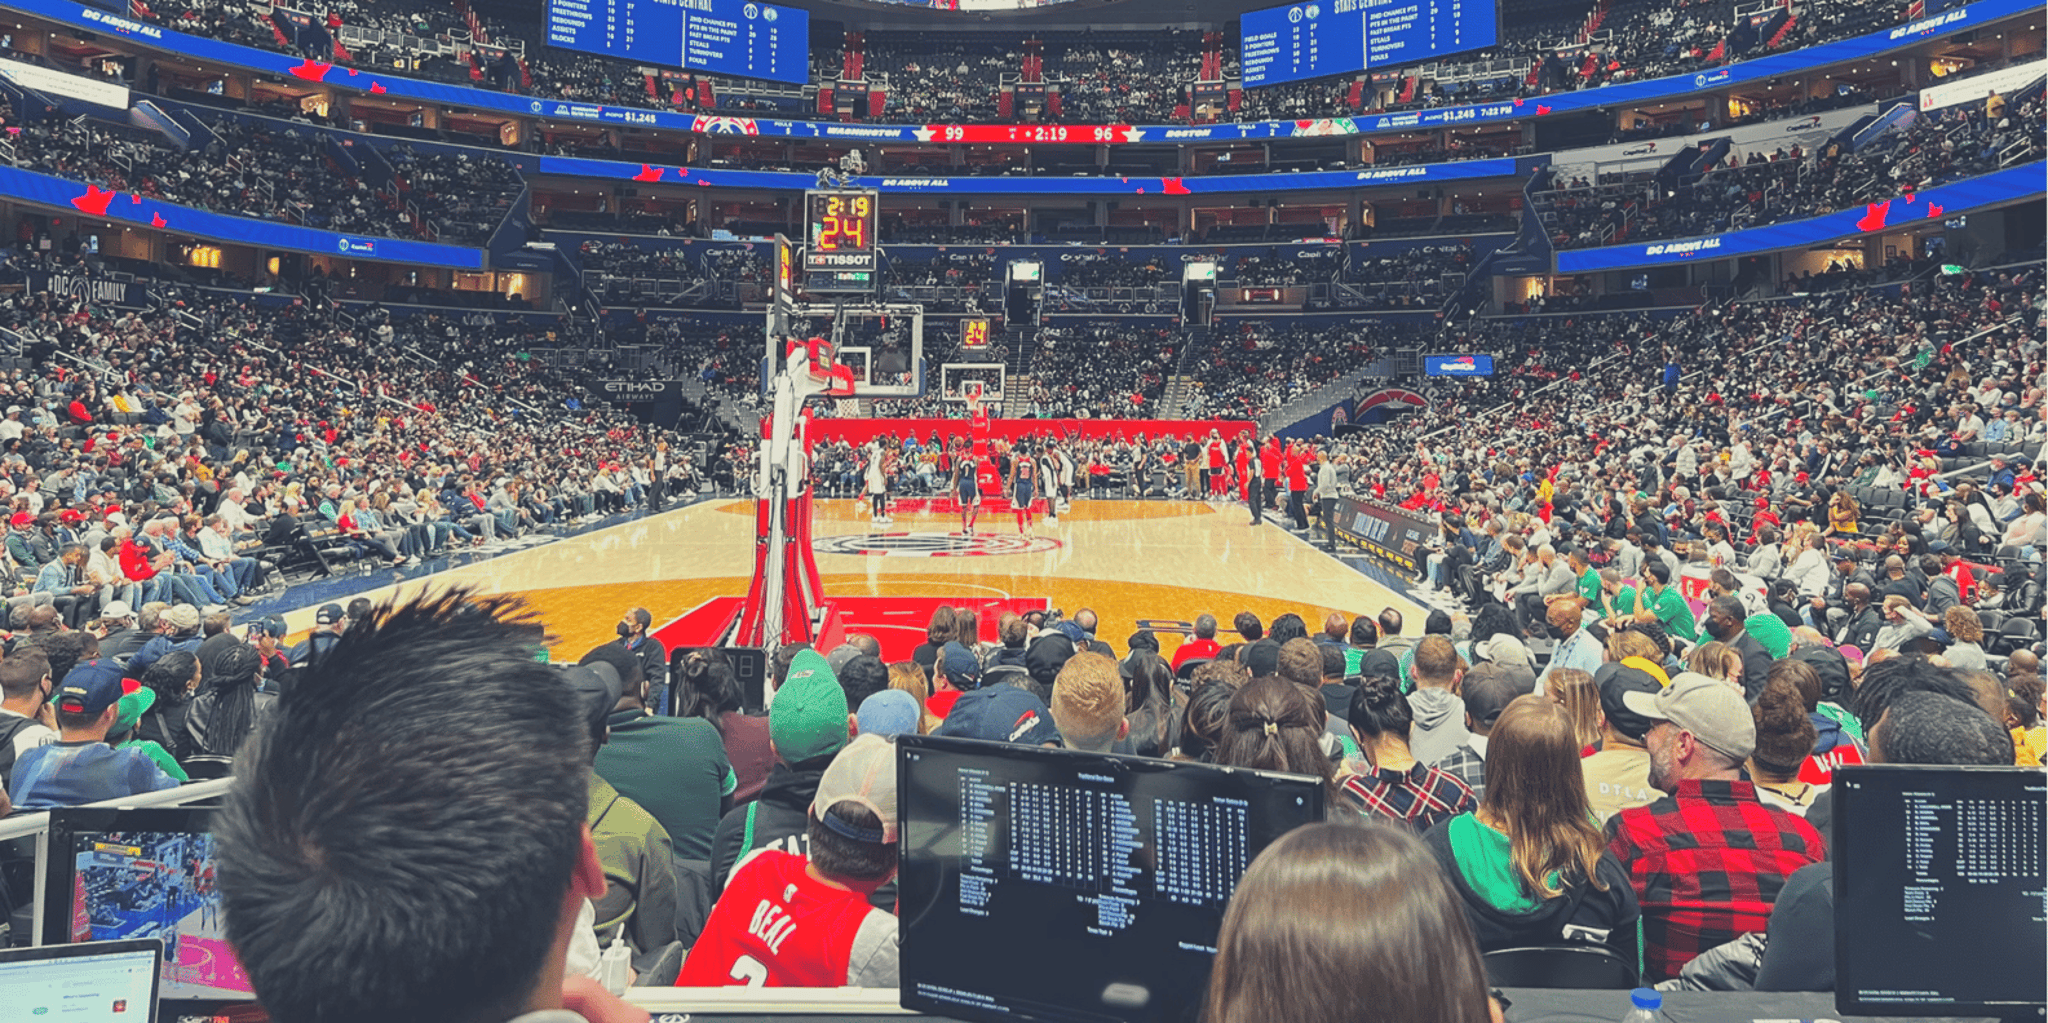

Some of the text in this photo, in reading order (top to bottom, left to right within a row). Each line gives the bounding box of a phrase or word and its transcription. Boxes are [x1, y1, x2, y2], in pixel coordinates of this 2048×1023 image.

[1384, 7, 1406, 17] CHANCE
[1400, 13, 1418, 22] PAINT
[82, 9, 162, 38] DC ABOVE ALL
[552, 16, 585, 27] REBOUNDS
[703, 18, 725, 26] CHANCE
[1890, 9, 1967, 40] DC ABOVE ALL
[552, 25, 576, 34] ASSISTS
[552, 34, 575, 43] BLOCKS
[1260, 32, 1277, 40] GOALS
[1370, 36, 1390, 45] STEALS
[690, 40, 709, 48] STEALS
[1371, 41, 1404, 53] TURNOVERS
[689, 48, 723, 58] TURNOVERS
[1371, 53, 1388, 62] FOULS
[689, 56, 707, 65] FOULS
[1245, 57, 1273, 66] REBOUNDS
[1245, 74, 1265, 82] BLOCKS
[625, 112, 656, 123] $1,245
[1443, 110, 1476, 122] $1,245
[1481, 108, 1498, 116] 7:22
[1500, 106, 1512, 114] PM
[827, 126, 902, 137] WASHINGTON
[946, 127, 964, 140] 99
[1035, 127, 1067, 140] 2:19
[1094, 127, 1113, 140] 96
[1166, 129, 1212, 137] BOSTON
[1357, 167, 1426, 180] DC ABOVE ALL
[827, 197, 868, 217] 2:19
[821, 217, 862, 248] 24
[1646, 238, 1720, 255] DC ABOVE ALL
[826, 255, 872, 265] TISSOT
[92, 280, 126, 302] FAMILY
[605, 382, 665, 392] ETIHAD
[1600, 783, 1647, 800] DTLA
[748, 899, 797, 956] BEAL
